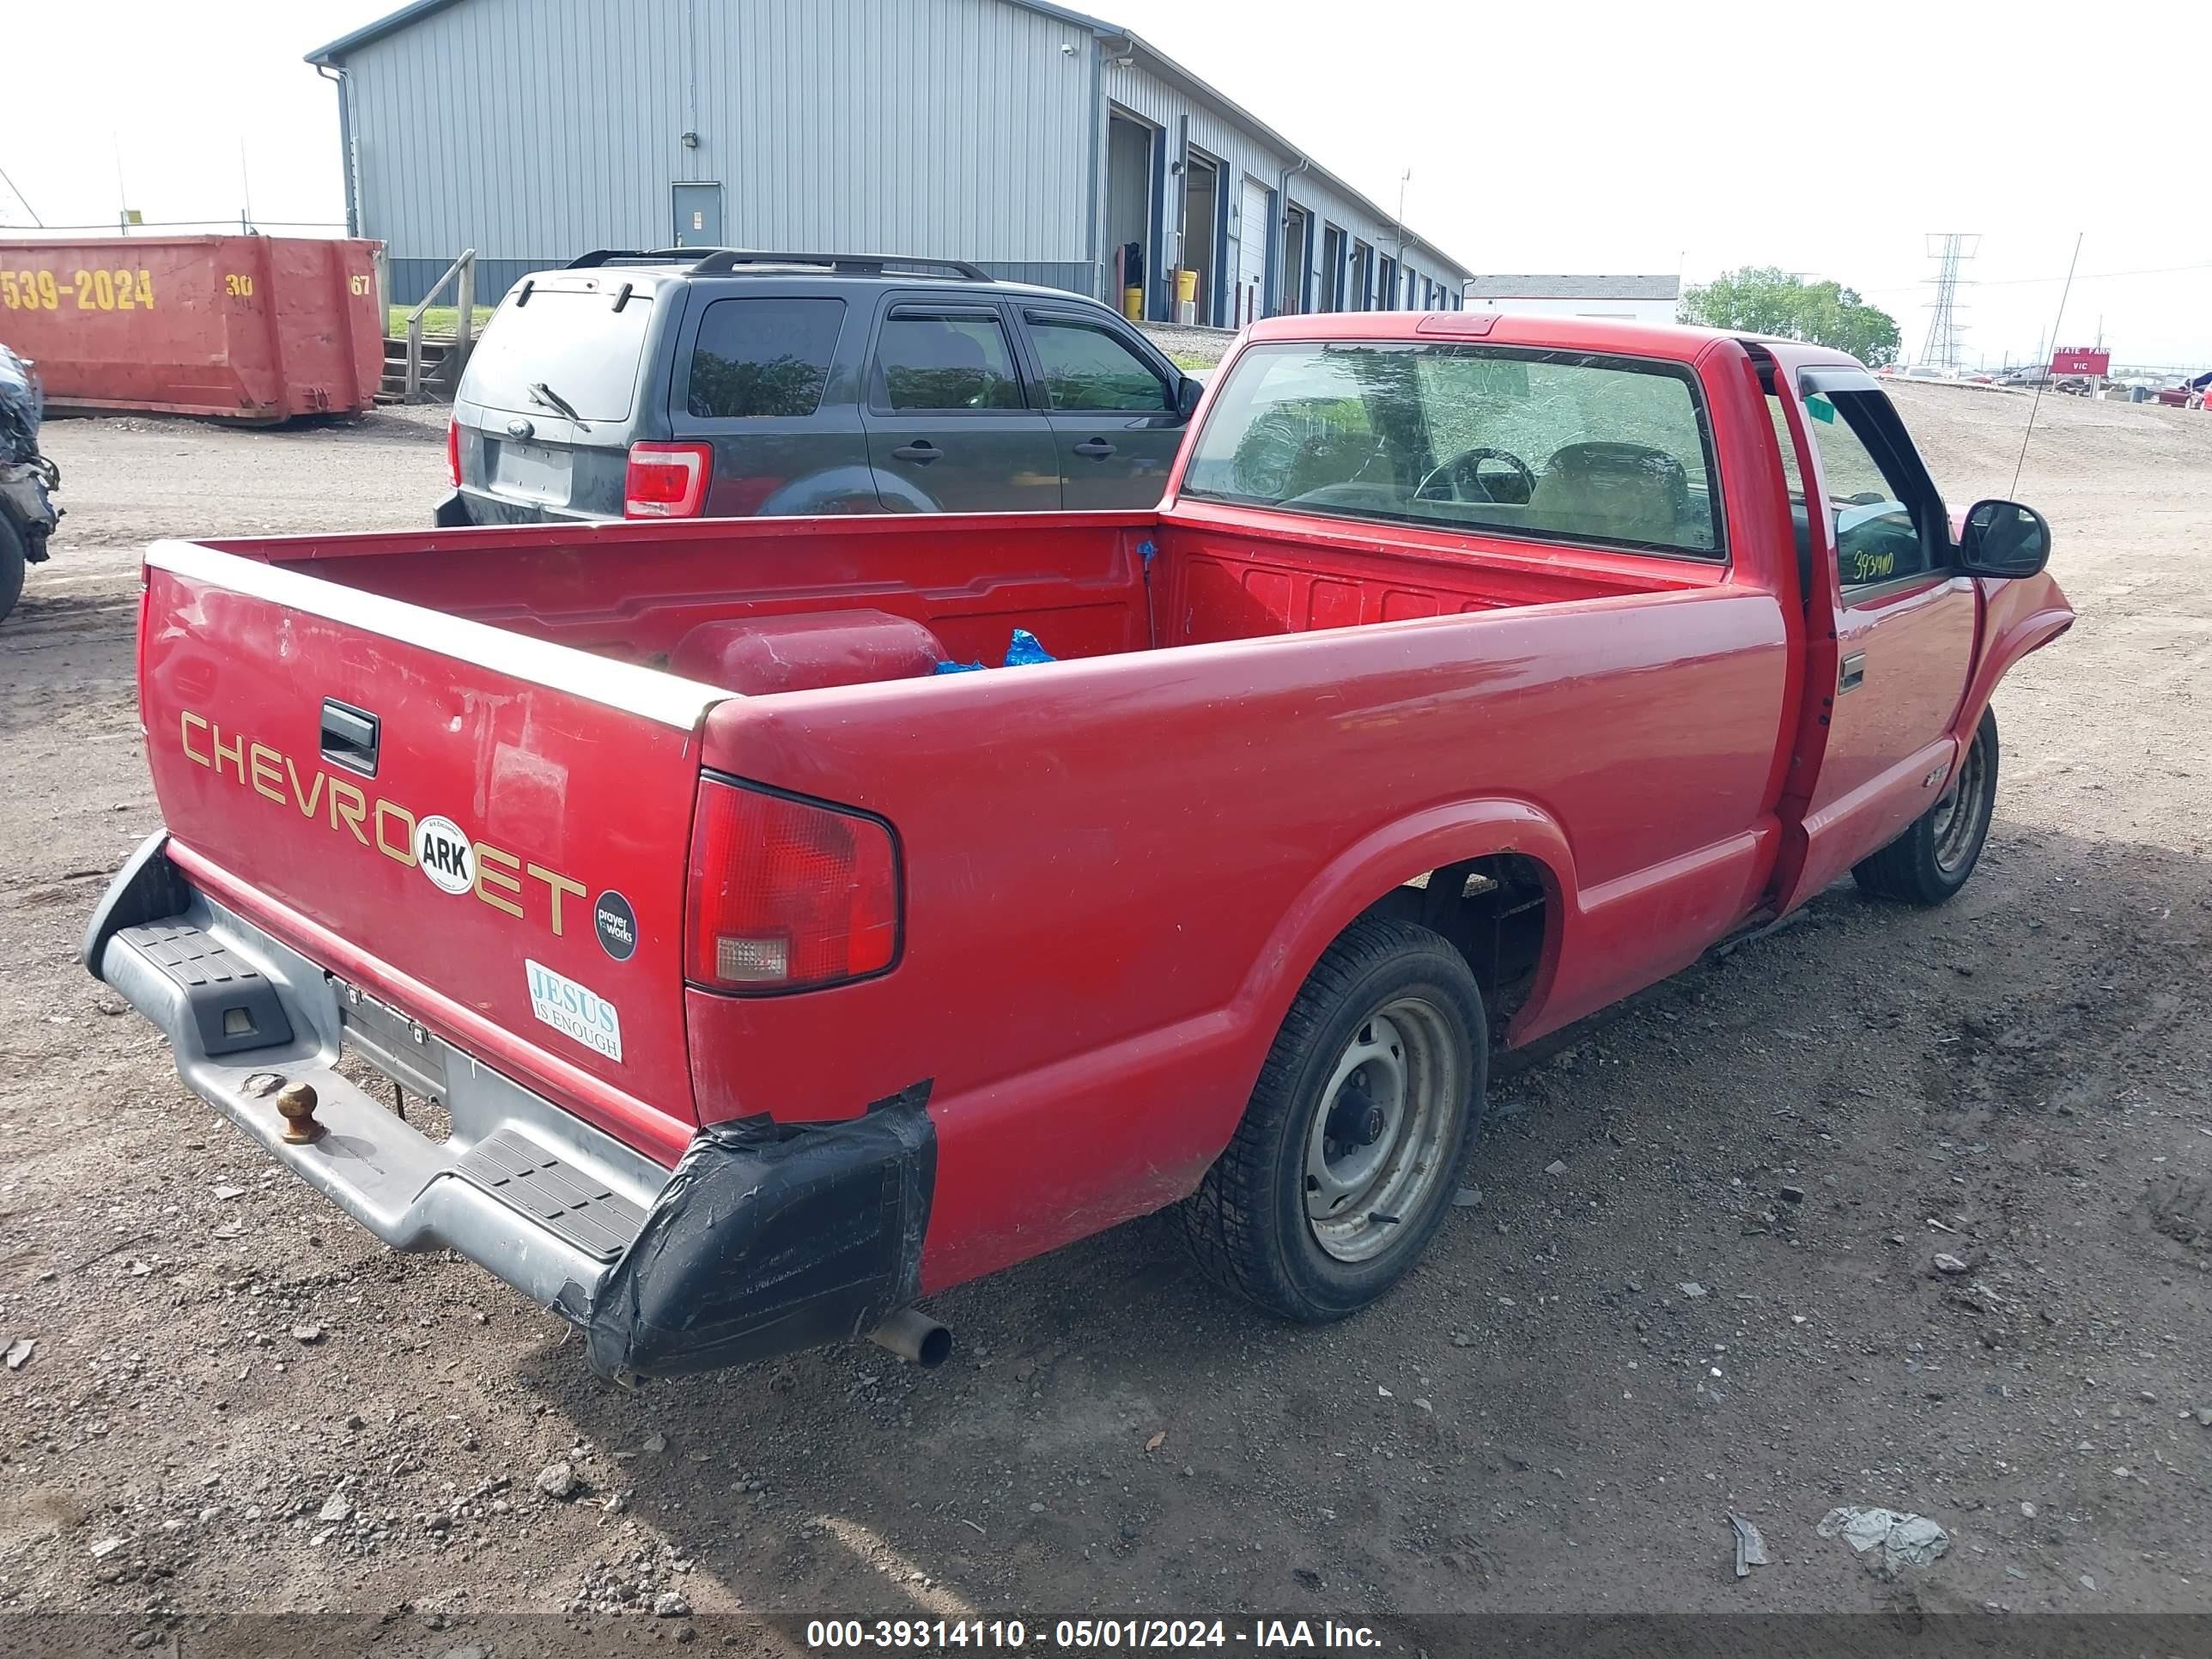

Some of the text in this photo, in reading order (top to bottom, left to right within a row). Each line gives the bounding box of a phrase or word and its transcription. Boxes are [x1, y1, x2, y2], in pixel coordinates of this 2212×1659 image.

[0, 270, 155, 310] 539-2024
[225, 274, 253, 296] 30
[423, 832, 469, 881] ARK
[599, 908, 628, 928] prayer
[606, 922, 633, 943] works
[533, 968, 615, 1033] JESUS
[535, 1000, 618, 1058] IS ENOUGH
